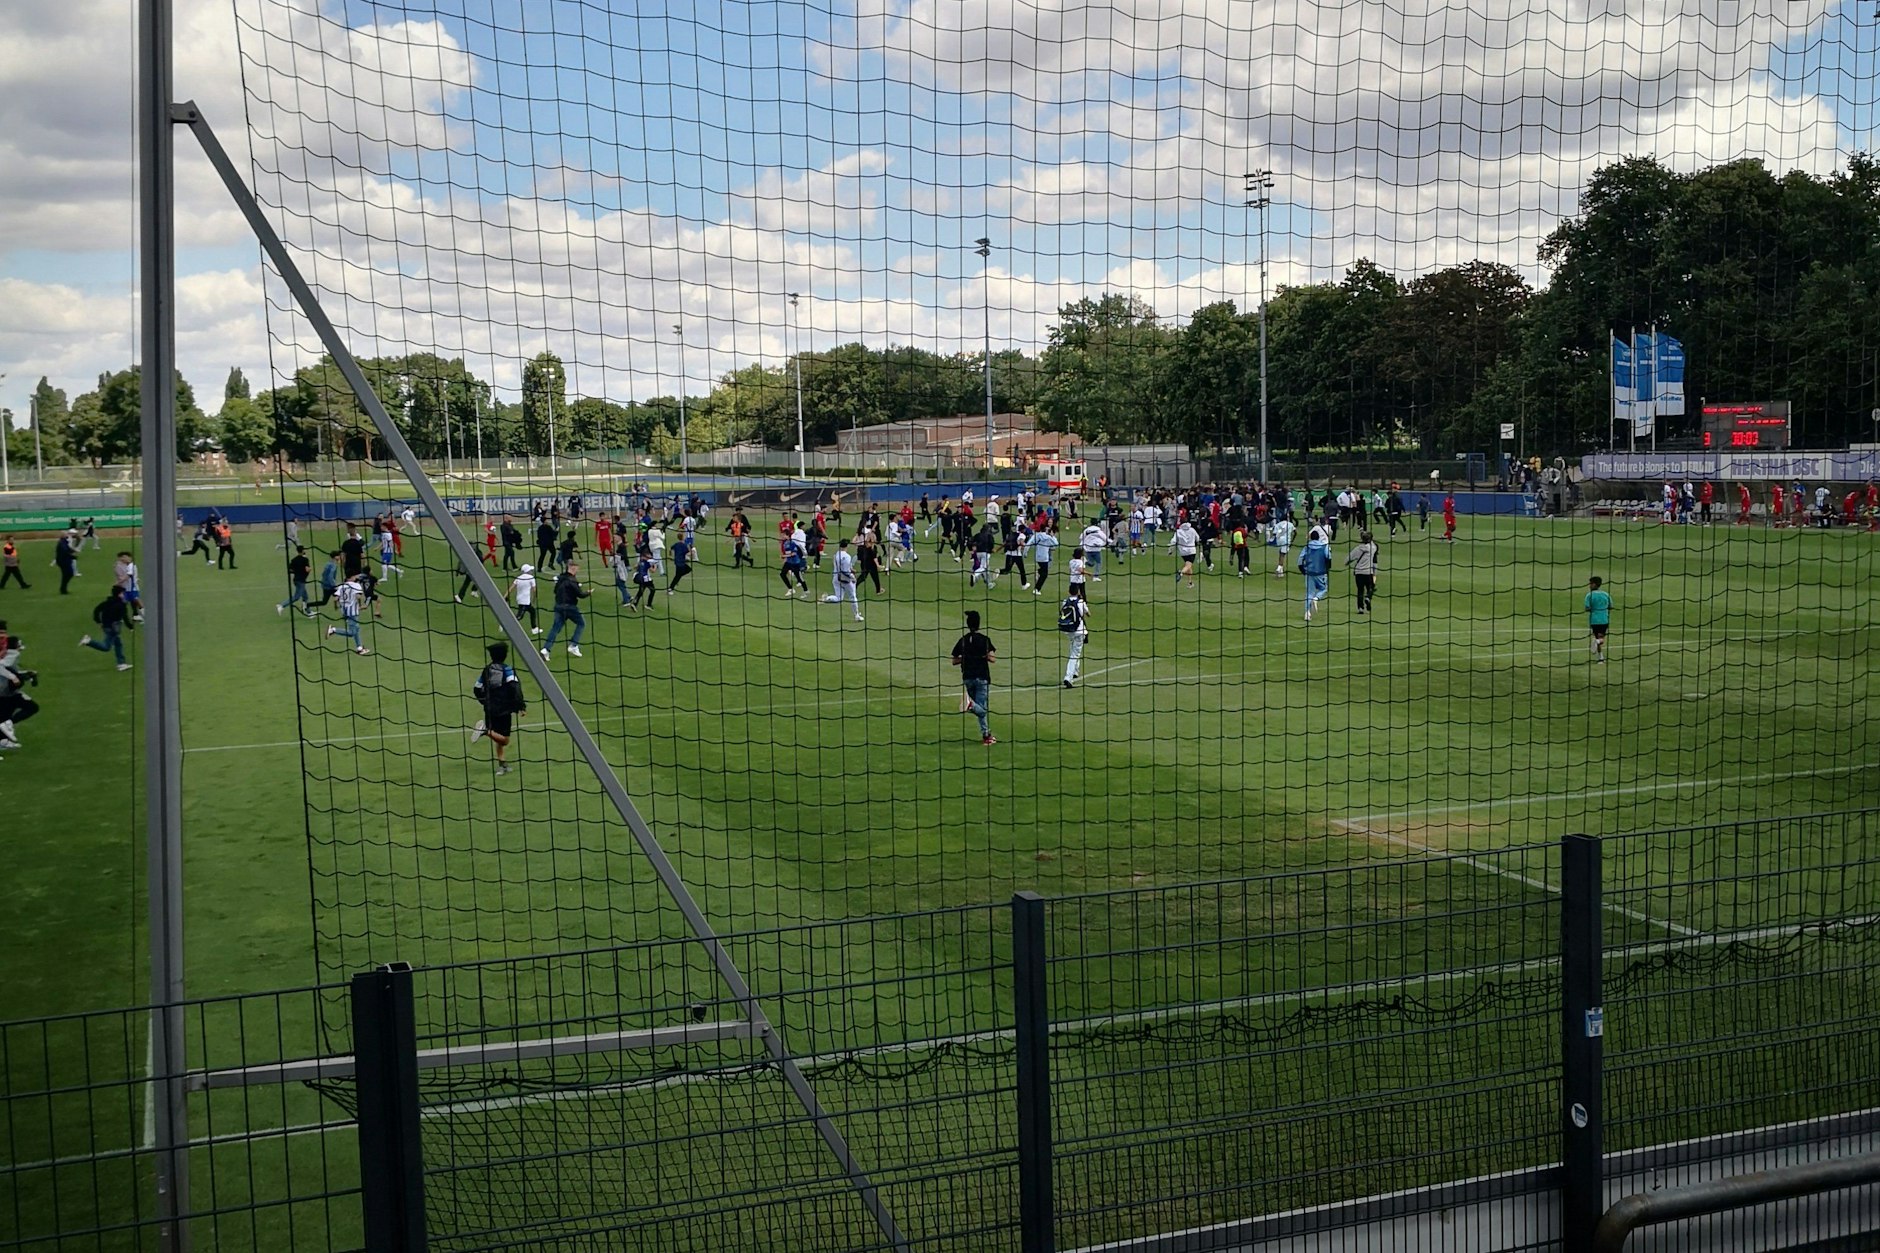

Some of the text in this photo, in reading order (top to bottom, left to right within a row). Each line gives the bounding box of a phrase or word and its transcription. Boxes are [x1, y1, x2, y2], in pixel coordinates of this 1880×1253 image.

[1599, 462, 1612, 472] The
[1613, 461, 1637, 472] future
[1671, 461, 1680, 472] to
[1731, 458, 1820, 475] HERTHA BSC
[448, 499, 470, 513] DIE
[472, 498, 530, 511] ZUKUNFT
